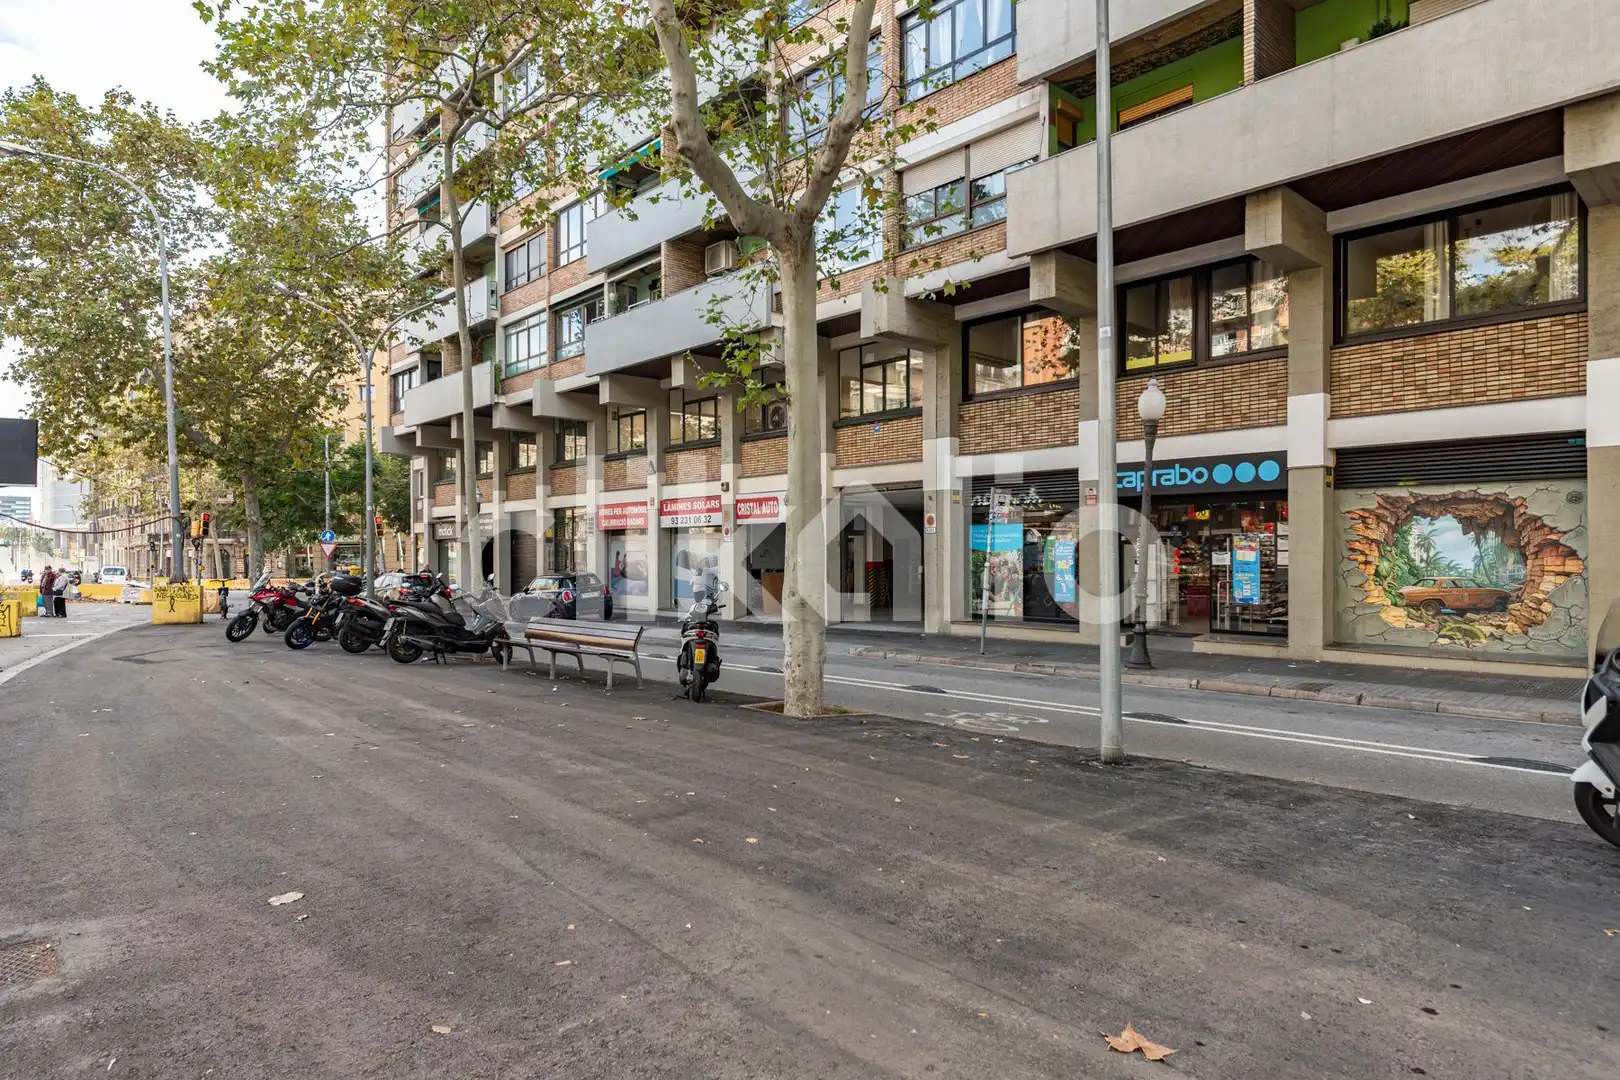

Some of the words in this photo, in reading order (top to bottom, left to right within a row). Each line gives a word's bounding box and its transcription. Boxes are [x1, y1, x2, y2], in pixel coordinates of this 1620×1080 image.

[692, 499, 720, 510] SOLARS
[737, 501, 761, 516] CRISTAL
[762, 500, 779, 514] AUTO
[670, 516, 679, 525] 93
[680, 516, 691, 525] 231
[703, 514, 712, 523] 32
